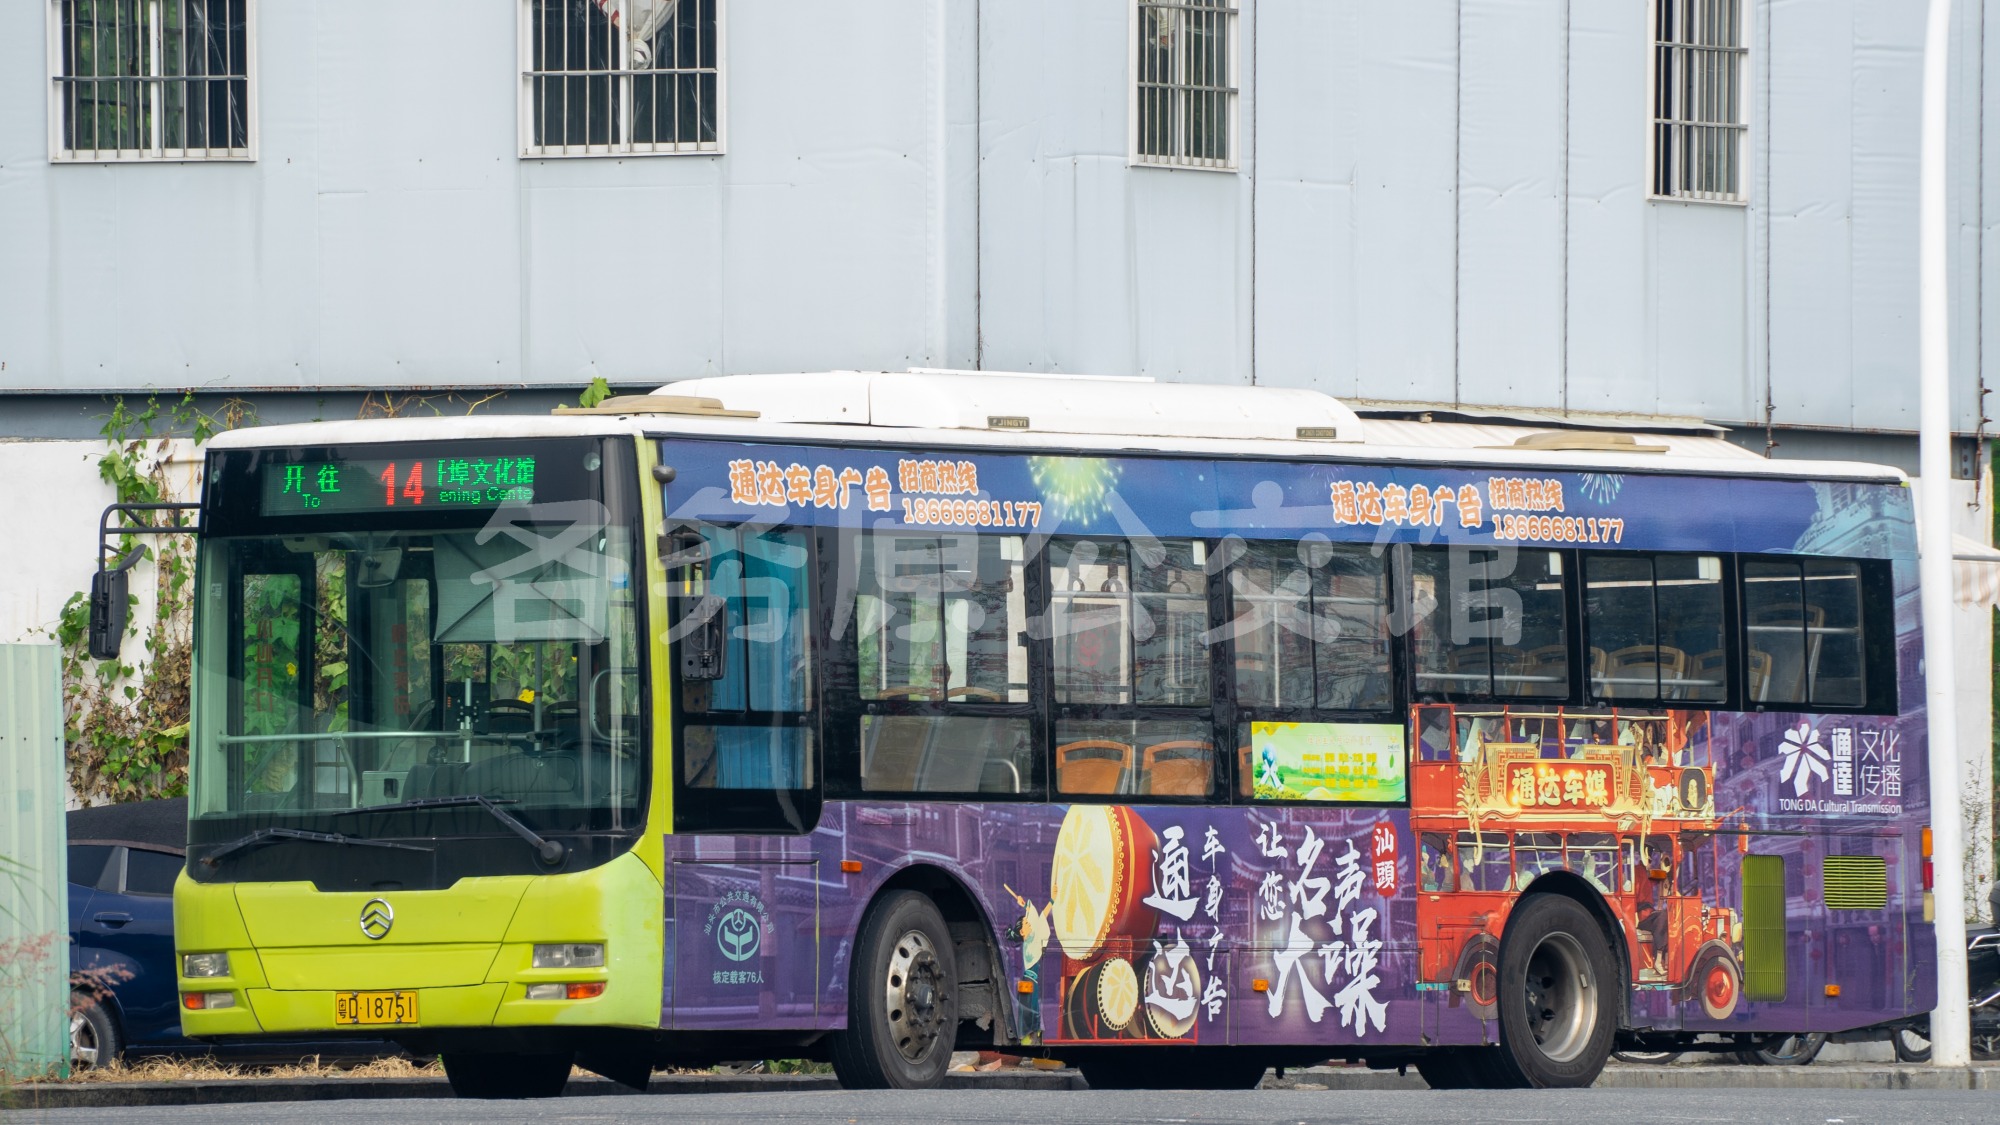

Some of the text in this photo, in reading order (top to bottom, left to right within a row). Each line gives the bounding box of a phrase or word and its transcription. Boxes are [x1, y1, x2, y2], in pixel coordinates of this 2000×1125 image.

[998, 419, 1027, 427] JINGYI
[283, 465, 341, 494] 开往
[381, 462, 425, 506] 14
[728, 458, 892, 512] 通达车身广告
[898, 459, 979, 496] 招商热线
[1488, 477, 1565, 512] 招商热线
[302, 494, 321, 508] To
[440, 487, 481, 505] ening
[903, 497, 1043, 528] 18666681177
[1330, 480, 1483, 529] 通达车身广告
[1492, 514, 1625, 544] 18666681177
[1832, 728, 1853, 796] 通達
[1860, 729, 1901, 762] 文化
[1512, 767, 1609, 807] 通达车媒
[1859, 765, 1902, 797] 传播
[1779, 799, 1903, 814] TONG DA Cultural Transmission
[1256, 822, 1288, 921] 让您
[1375, 827, 1396, 890] 汕頭
[703, 890, 775, 936] 汕头市公共交通有限公司
[1143, 825, 1200, 1021] 通达
[1201, 825, 1228, 1022] 车身广告
[713, 970, 765, 985] 核定载客76人
